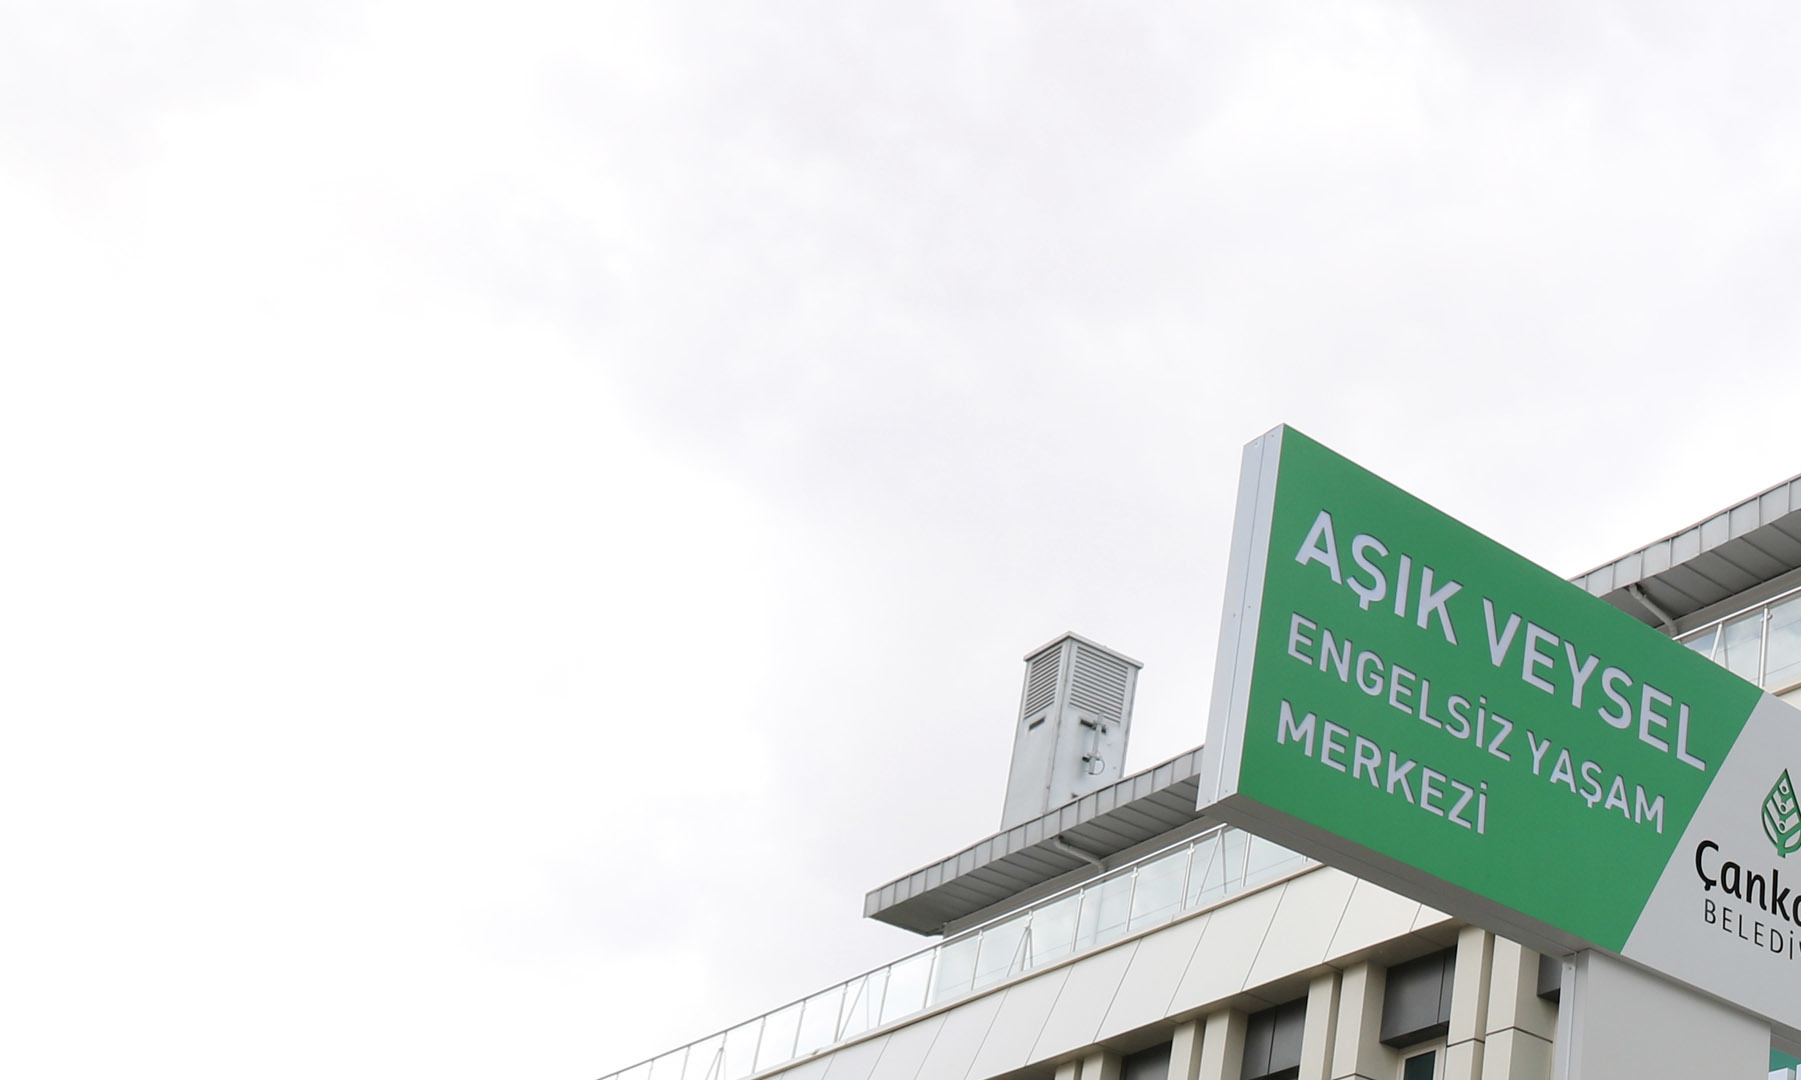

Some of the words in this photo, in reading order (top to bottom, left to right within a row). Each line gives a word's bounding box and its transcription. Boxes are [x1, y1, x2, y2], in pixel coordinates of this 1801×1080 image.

[1286, 611, 1513, 762] ENGELSİZ
[1526, 730, 1665, 835] YAŞAM
[1295, 509, 1463, 646] AŞIK
[1483, 597, 1707, 772] VEYSEL
[1276, 700, 1488, 835] MERKEZİ
